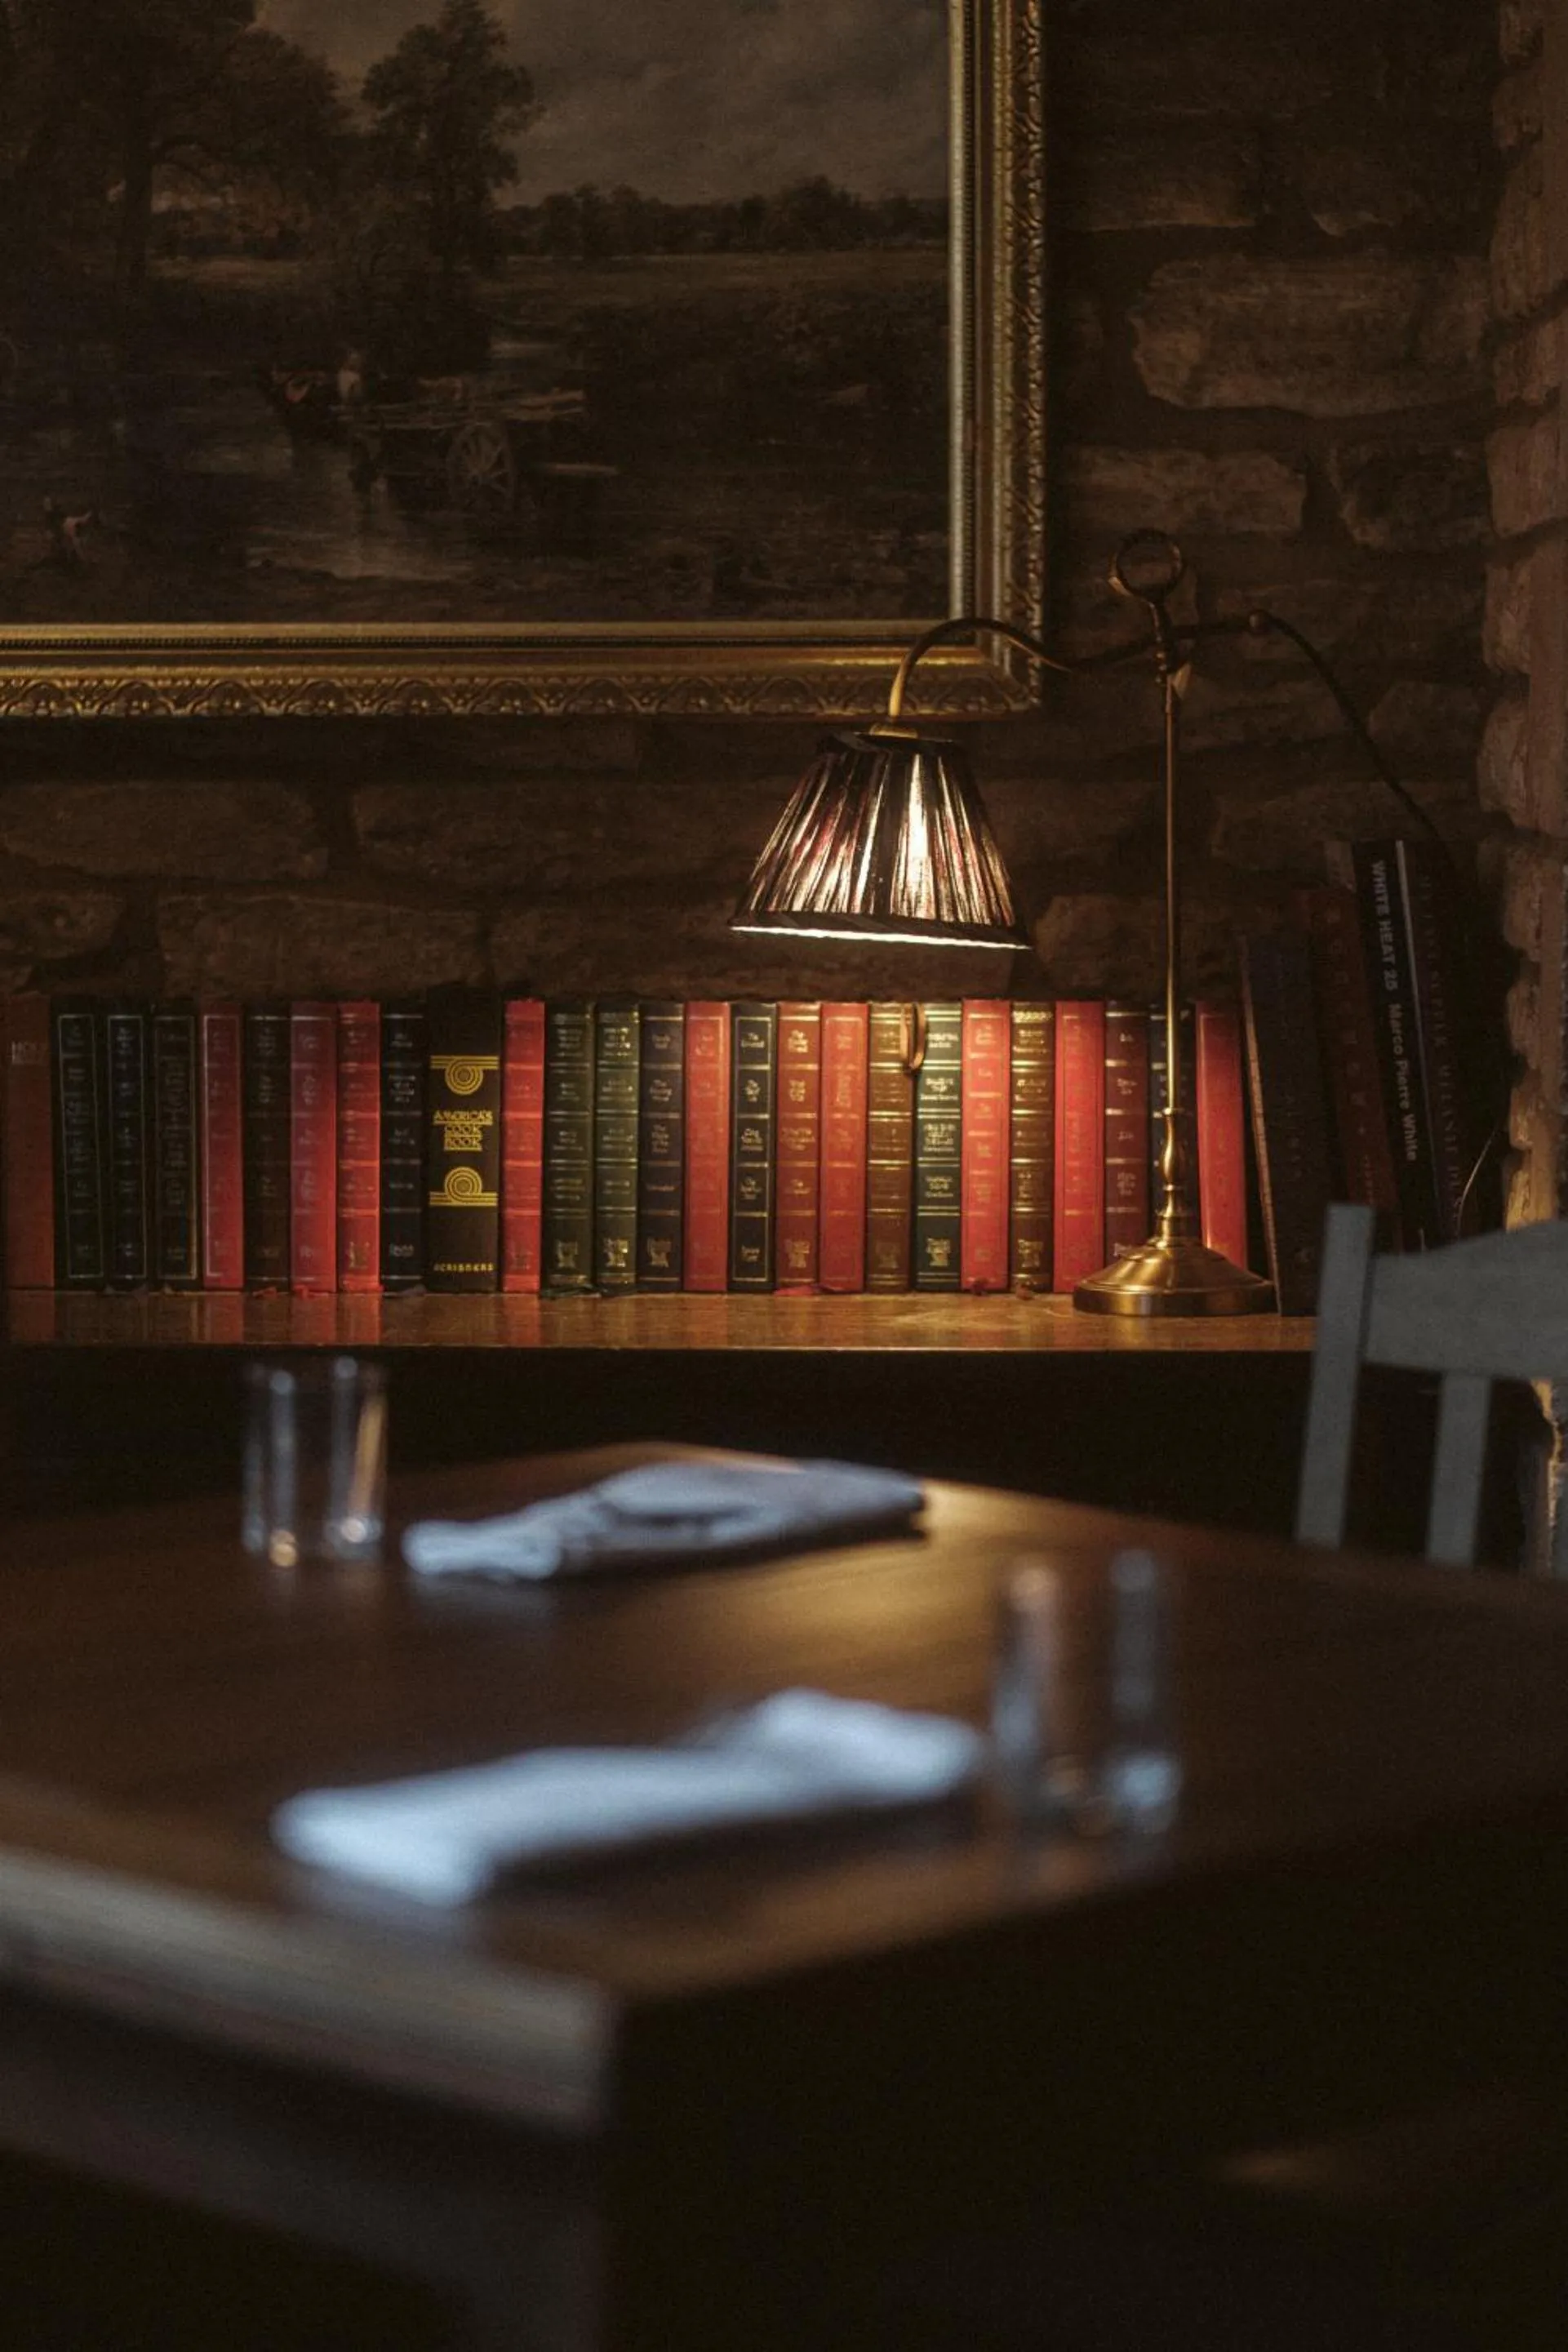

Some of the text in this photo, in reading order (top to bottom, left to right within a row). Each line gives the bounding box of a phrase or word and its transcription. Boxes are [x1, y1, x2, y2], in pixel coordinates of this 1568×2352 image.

[1370, 860, 1391, 915] WHITE
[1376, 919, 1397, 964] HEAT
[1386, 1003, 1419, 1161] Marco Pierre White
